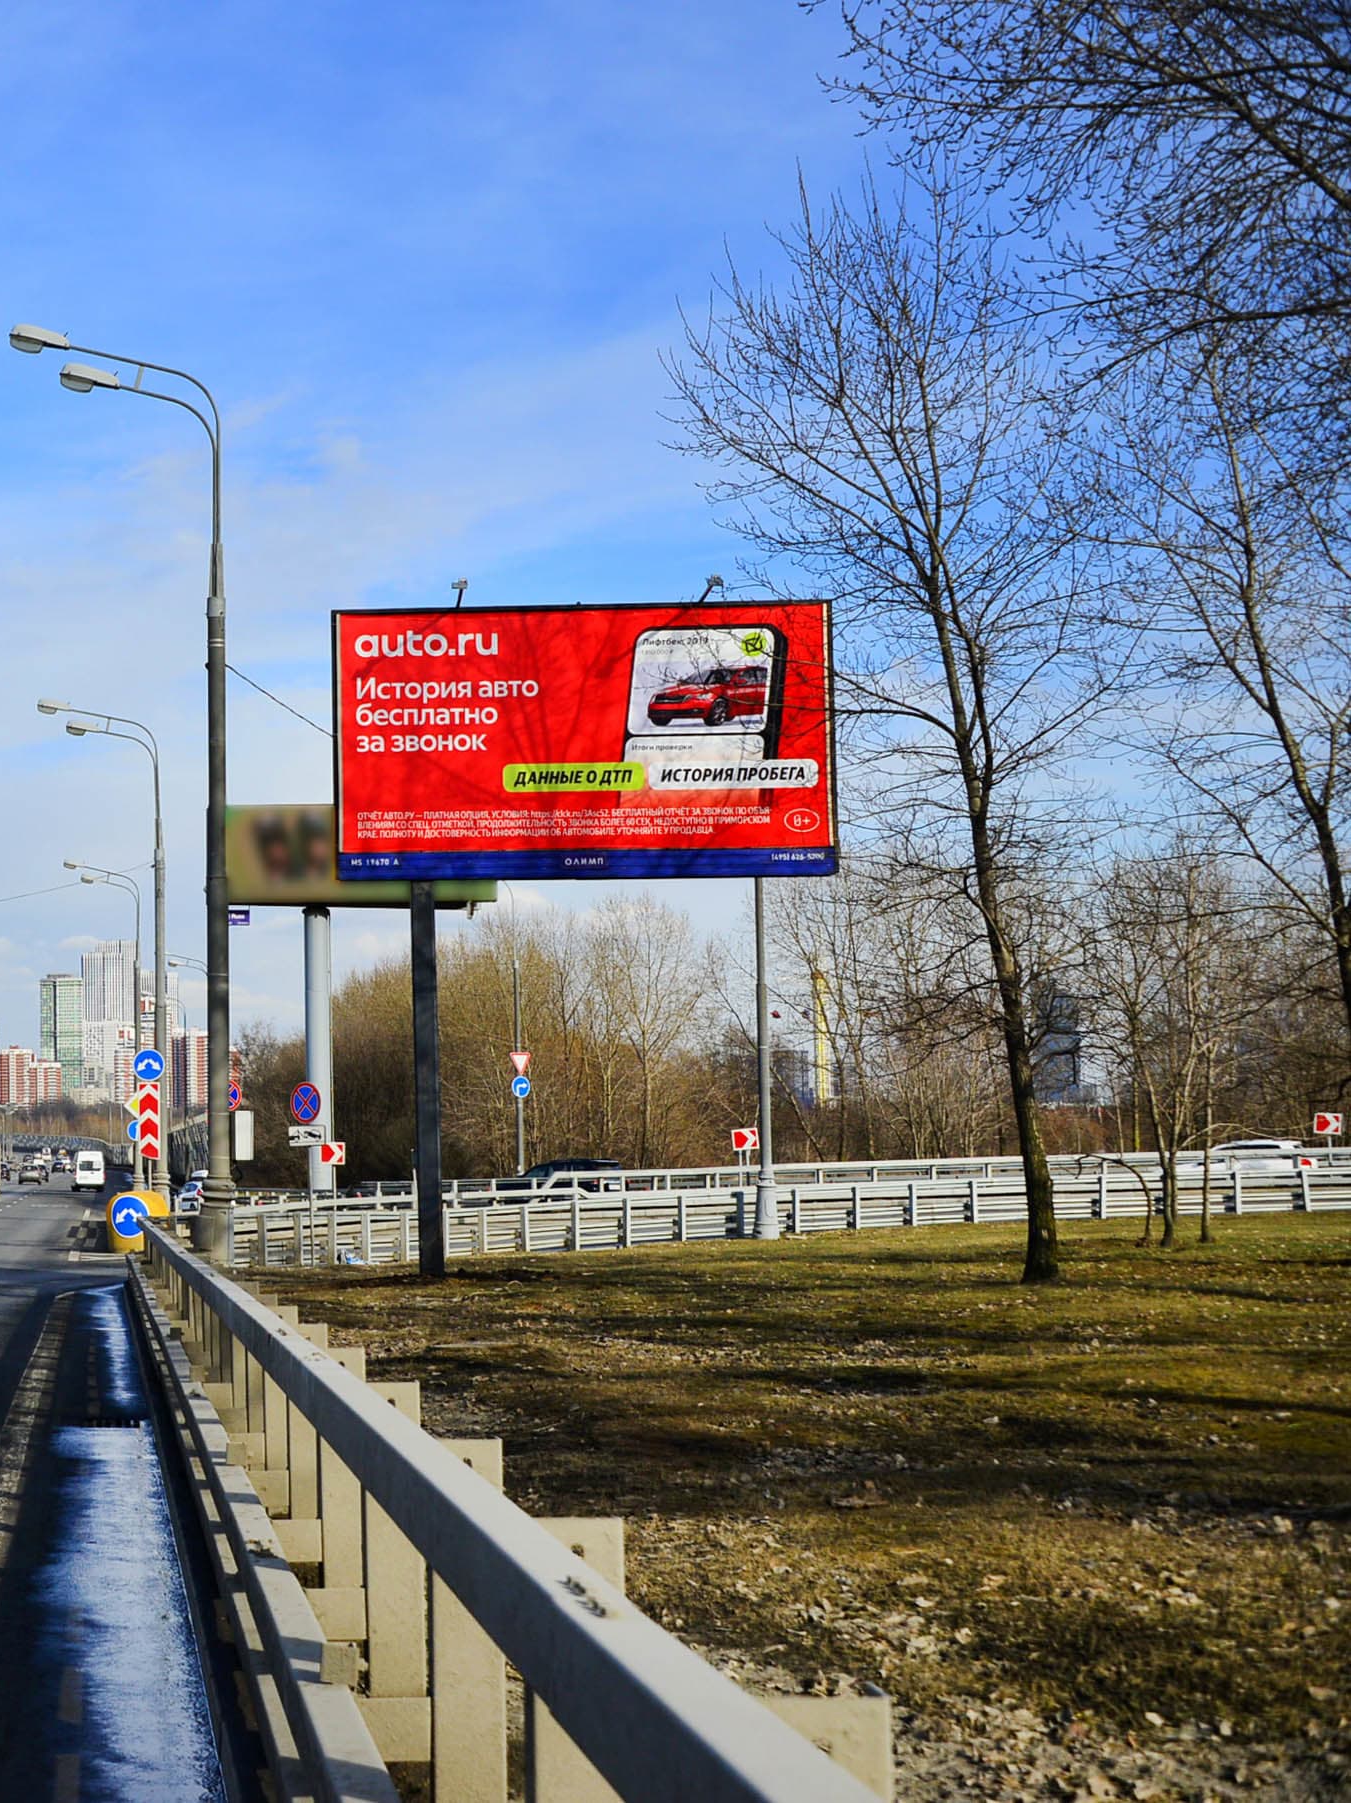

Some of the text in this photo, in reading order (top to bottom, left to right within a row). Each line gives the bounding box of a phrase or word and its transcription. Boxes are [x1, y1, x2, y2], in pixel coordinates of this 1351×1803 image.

[354, 630, 499, 657] auto.ru
[356, 676, 539, 704] История авто
[355, 703, 498, 726] бесплатно
[356, 734, 488, 752] за звонок
[514, 769, 634, 787] ДАННЫЕ О ДТП
[660, 765, 806, 783] ИСТОРИЯ ПРОБЕГА
[357, 810, 382, 820] ОТЧЁТ
[383, 811, 415, 820] АВТО.РУ
[423, 810, 459, 819] ПЛАТНАЯ
[611, 806, 664, 817] БЕСПЛАТНЫЙ
[664, 806, 690, 816] ОТЧЁТ
[691, 807, 701, 815] ЗА
[702, 807, 733, 815] ЗВОНОК
[735, 806, 747, 815] ПО
[357, 820, 395, 830] ВЛЕНИЯМ
[396, 820, 407, 829] СО
[476, 818, 567, 829] ПРОДОЛЖИТЕЛЬНОСТЬ
[569, 817, 598, 827] ЗВОНКА
[600, 817, 624, 826] БОЛЕЕ
[653, 816, 707, 826] НЕДОСТУПНО
[708, 816, 714, 824] В
[715, 815, 770, 825] ПРИМОРСКОМ
[379, 829, 417, 839] ПОЛНОТУ
[417, 829, 424, 838] И
[424, 828, 491, 839] ДОСТОВЕРНОСТЬ
[492, 827, 549, 838] ИНФОРМАЦИИ
[550, 827, 561, 836] ОБ
[562, 826, 616, 836] АВТОМОБИЛЕ
[616, 825, 663, 836] УТОЧНЯЙТЕ
[663, 825, 670, 834] У
[564, 857, 604, 866] ОЛИМП
